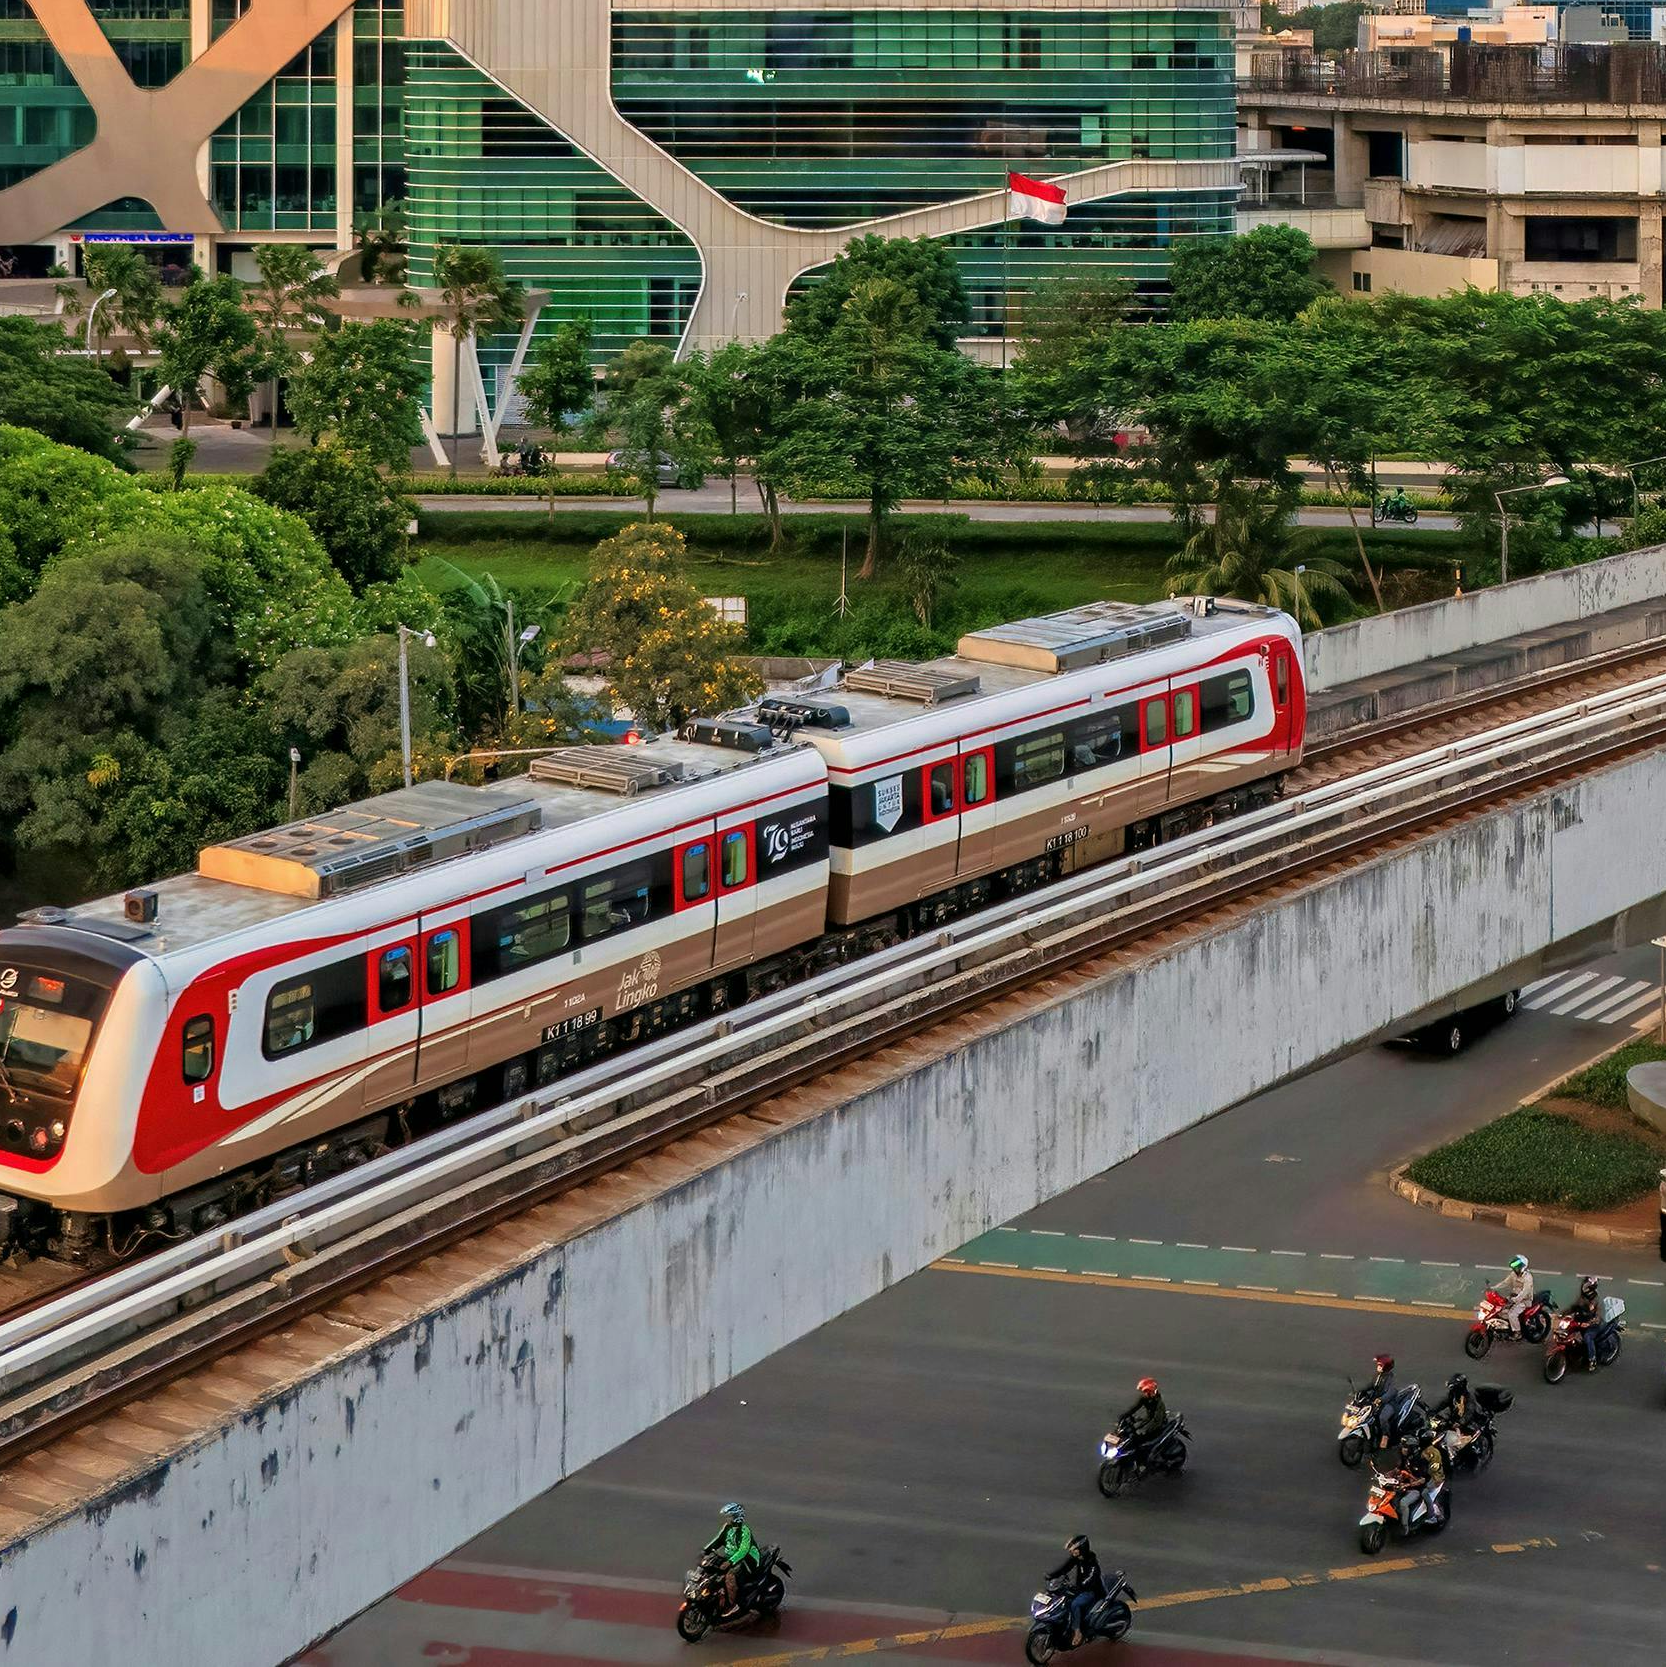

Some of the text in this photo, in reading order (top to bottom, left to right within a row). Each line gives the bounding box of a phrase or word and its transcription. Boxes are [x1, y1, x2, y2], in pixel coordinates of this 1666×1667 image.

[617, 968, 642, 992] Jak
[615, 982, 658, 1011] Lingko
[546, 1009, 597, 1040] K1 1 18 99
